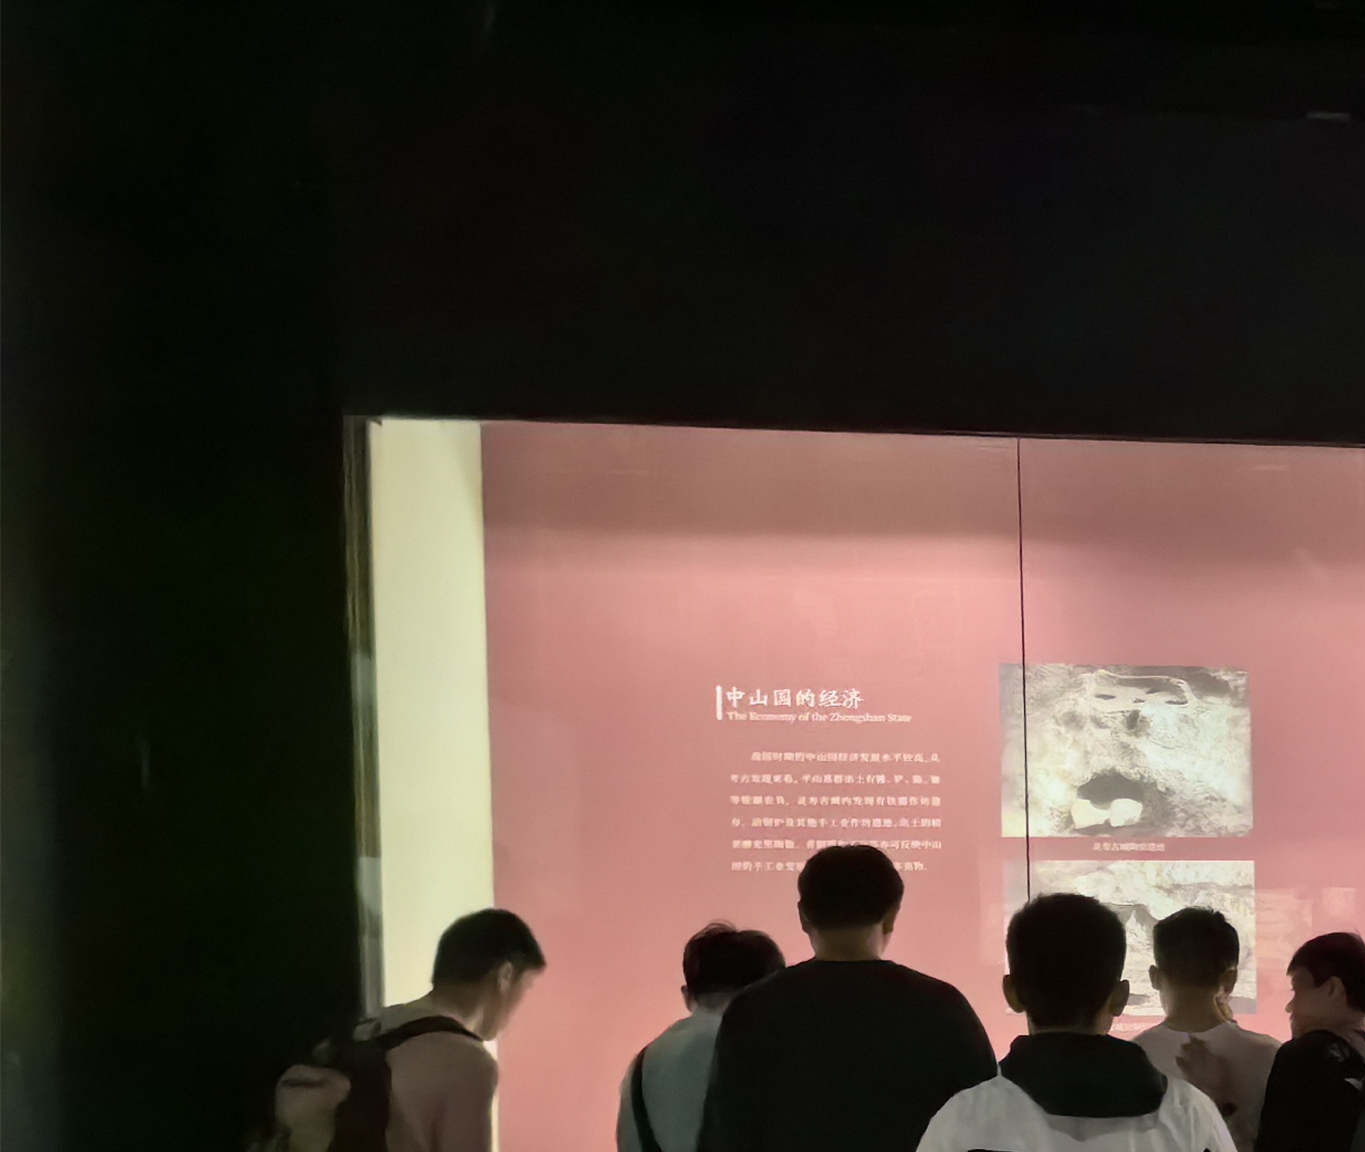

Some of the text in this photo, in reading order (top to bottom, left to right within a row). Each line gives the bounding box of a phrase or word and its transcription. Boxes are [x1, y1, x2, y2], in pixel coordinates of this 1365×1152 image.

[726, 686, 864, 710] 中山国的经济
[727, 711, 747, 721] The
[798, 710, 810, 722] of
